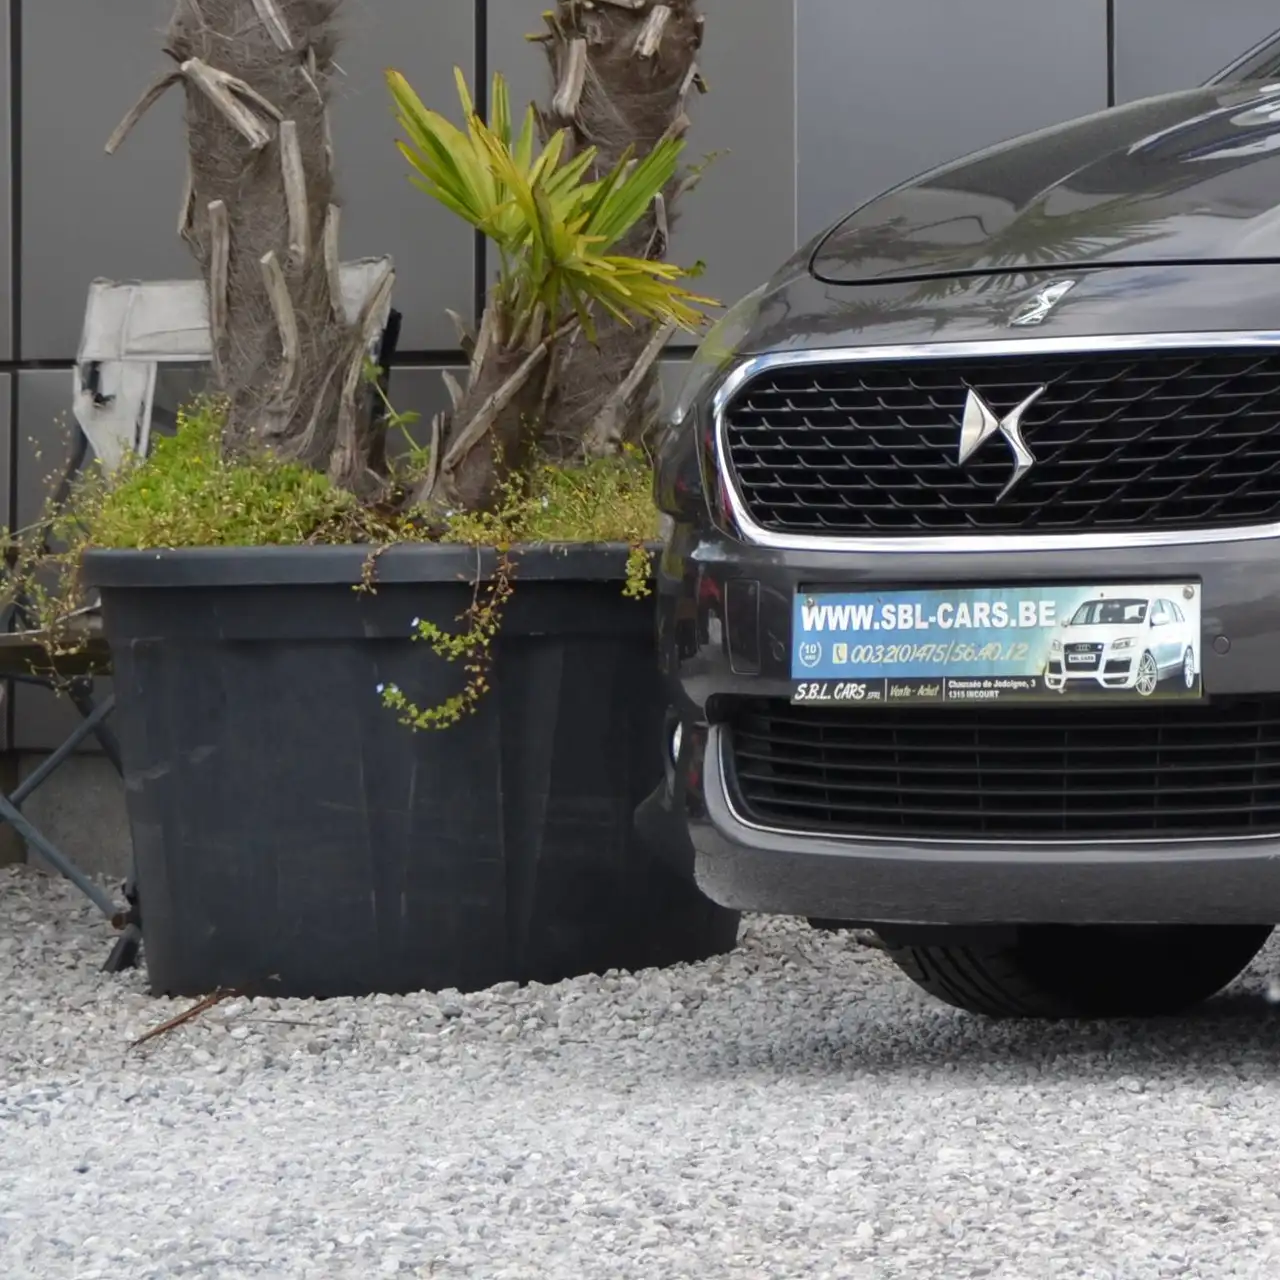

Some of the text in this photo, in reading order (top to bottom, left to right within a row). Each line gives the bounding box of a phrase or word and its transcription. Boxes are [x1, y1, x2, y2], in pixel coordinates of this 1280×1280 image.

[801, 600, 1056, 632] WWW.SBL-CARS.BE
[805, 643, 817, 654] 10
[794, 682, 831, 701] S.B.L.
[833, 682, 866, 701] CARS
